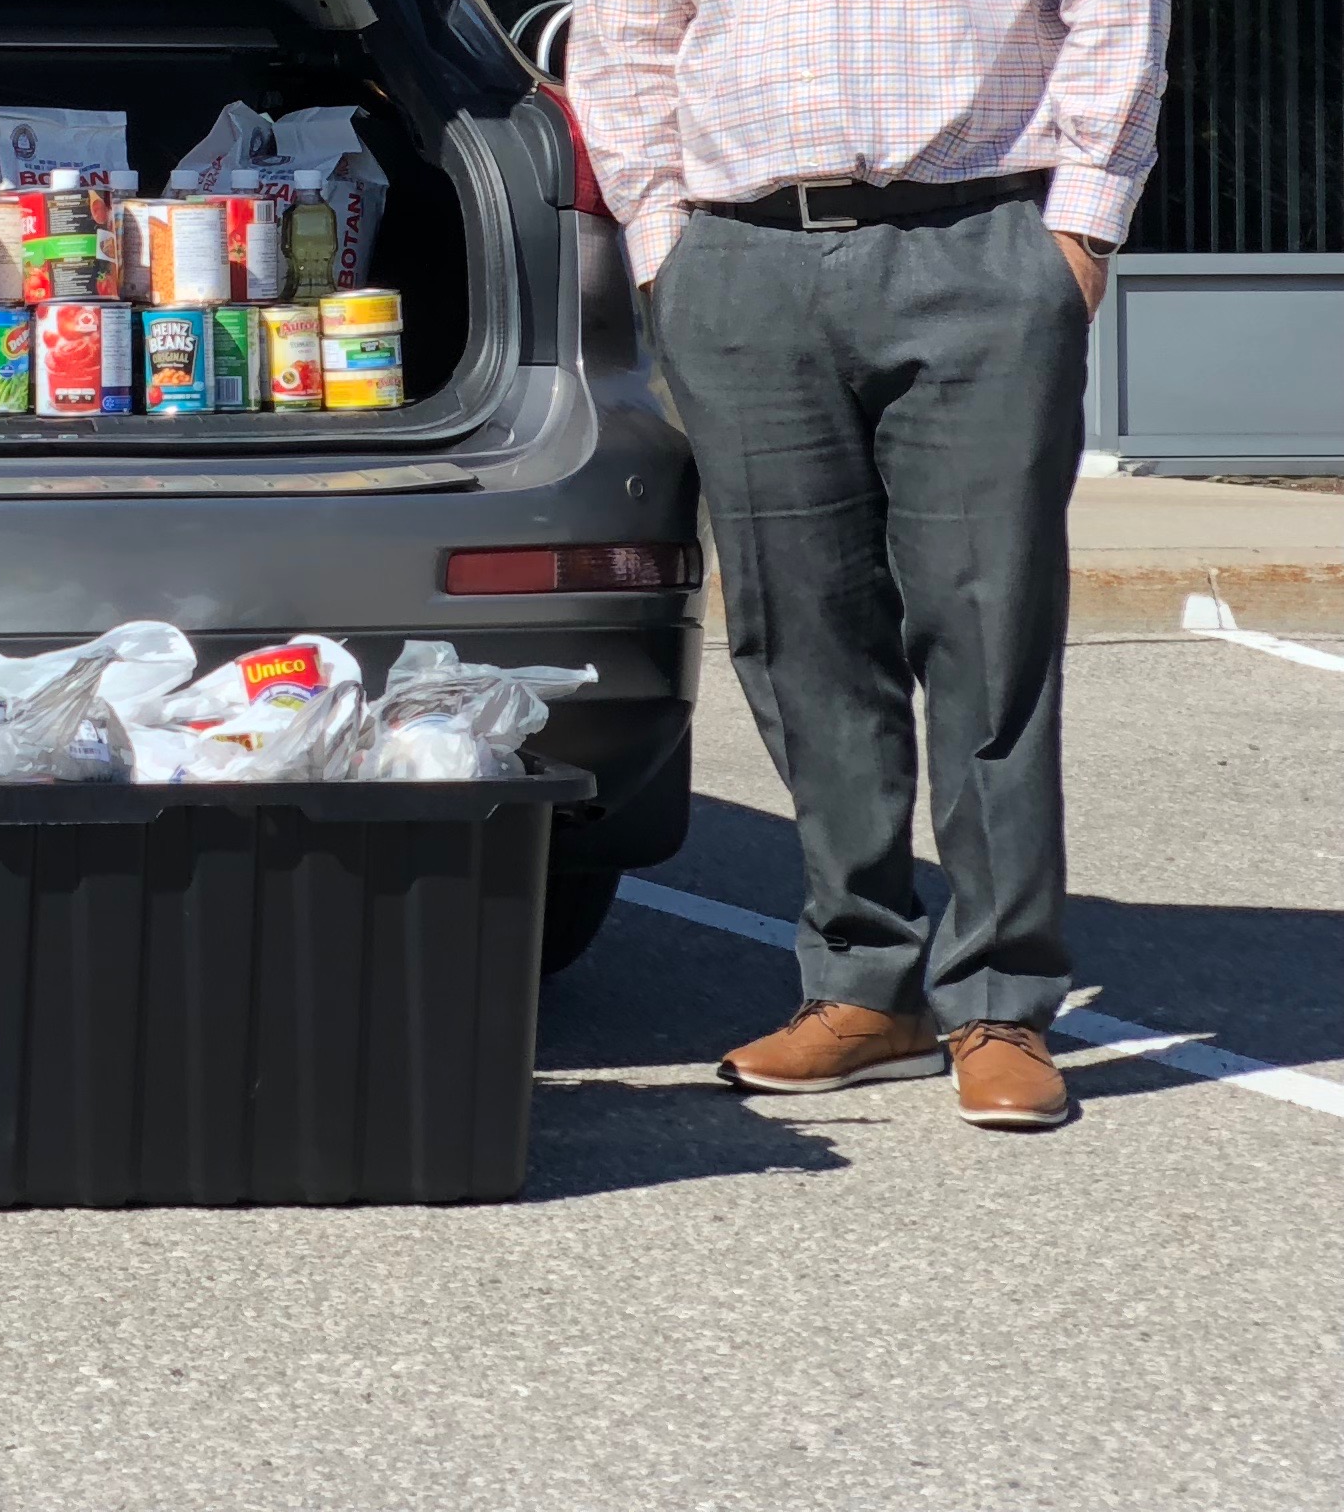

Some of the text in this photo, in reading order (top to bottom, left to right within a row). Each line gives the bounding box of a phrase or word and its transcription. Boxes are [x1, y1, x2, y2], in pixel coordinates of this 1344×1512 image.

[19, 170, 110, 187] BOAN
[337, 192, 363, 290] BOTAN
[151, 322, 189, 336] HEINZ
[149, 335, 195, 354] BEANS
[246, 659, 306, 684] Unico
